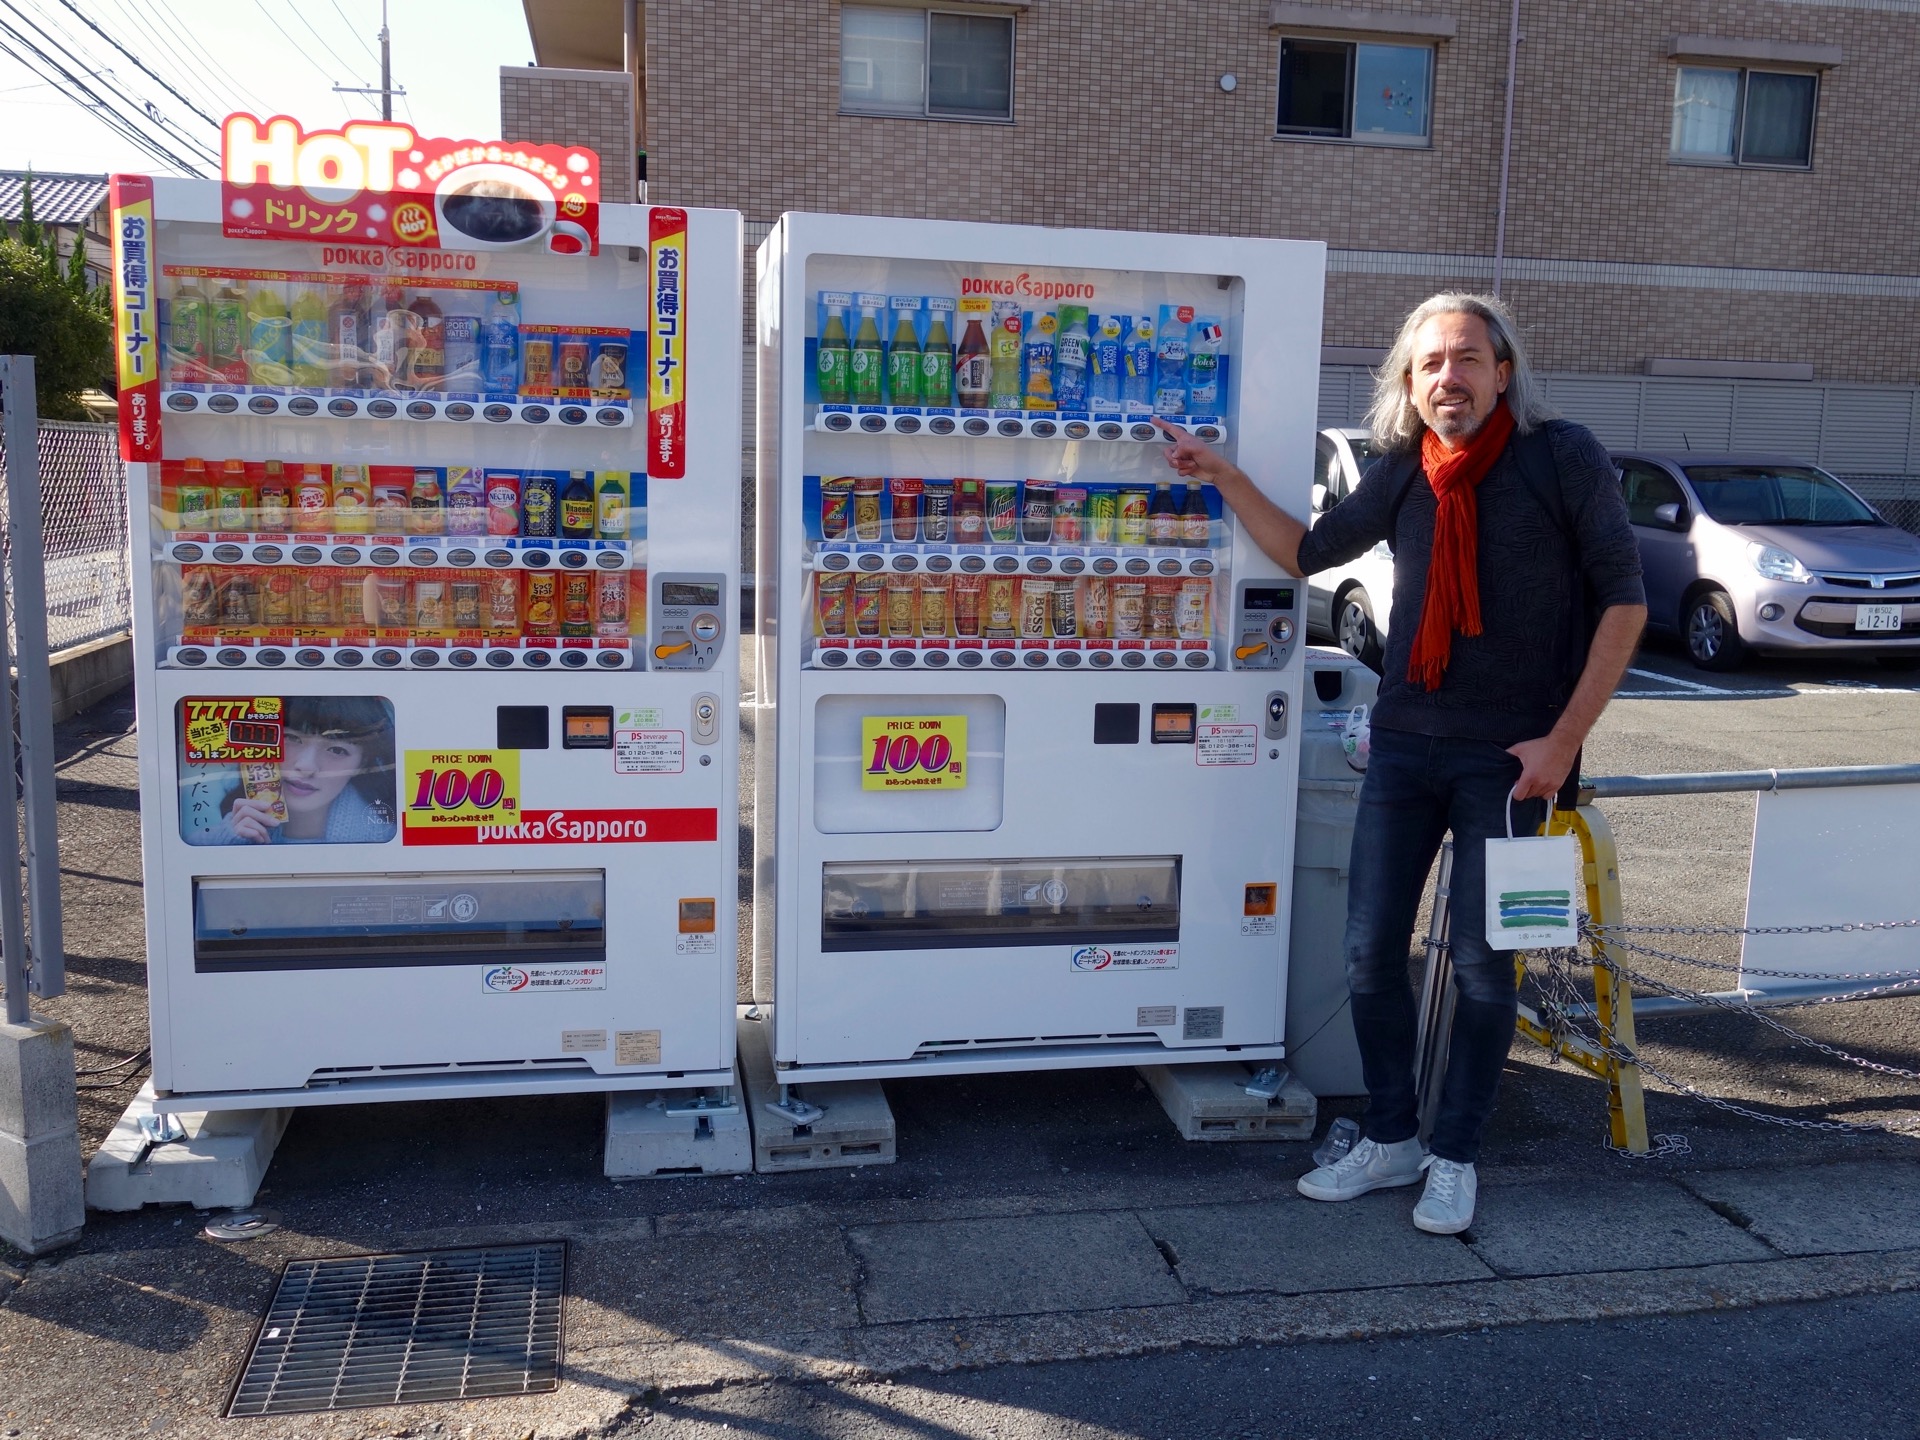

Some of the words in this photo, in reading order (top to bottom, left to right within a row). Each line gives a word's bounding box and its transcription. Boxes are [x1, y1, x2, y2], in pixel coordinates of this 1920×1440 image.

[227, 116, 414, 206] HOT
[266, 199, 358, 235] ドリンク
[401, 220, 425, 233] HOT
[323, 247, 383, 265] pokka
[386, 246, 476, 272] sapporo
[175, 267, 230, 277] お買得コーナー
[454, 280, 507, 290] お買得コーナー
[962, 278, 1014, 296] pokka
[1016, 273, 1095, 300] sapporo
[121, 216, 148, 374] お買得コーナー
[446, 321, 472, 330] SPORTS
[656, 247, 680, 395] お買得コーナー
[447, 329, 471, 338] WATER
[571, 327, 620, 336] お買得コーナー
[1061, 337, 1080, 348] GREEN
[1029, 346, 1053, 358] キリン
[820, 352, 832, 371] 茶
[854, 352, 866, 371] 茶
[924, 356, 937, 375] 茶
[1029, 357, 1053, 368] レモン
[836, 354, 844, 387] 伊右衛門
[870, 355, 878, 387] 伊右衛門
[901, 357, 910, 389] 伊右衛門
[940, 358, 948, 390] 伊右衛門
[131, 392, 151, 451] あります。
[659, 413, 676, 468] あります。
[489, 493, 516, 502] NECTAR
[527, 492, 545, 500] レモン
[937, 498, 948, 539] BLACK
[533, 582, 553, 590] じっくり
[491, 594, 515, 603] ミルク
[493, 603, 515, 613] カフェ
[1032, 596, 1046, 634] BOSS
[1065, 594, 1075, 634] BLACK
[1867, 615, 1899, 628] 12-18
[193, 628, 250, 637] お買得コーナー
[269, 628, 326, 637] お買得コーナー
[385, 629, 440, 638] お買得コーナー
[458, 629, 512, 638] お買得コーナー
[256, 699, 279, 709] LUCKY
[187, 701, 250, 720] 7777
[189, 722, 225, 740] 当たる!
[887, 721, 915, 730] PRICE
[919, 721, 942, 730] DOWN
[1221, 727, 1244, 735] beverage
[233, 723, 278, 742] 7777
[643, 733, 668, 742] beverage
[188, 744, 281, 760] もう1本プレゼント!
[431, 755, 462, 764] PRICE
[467, 755, 492, 764] DOWN
[246, 763, 275, 772] じっくり
[248, 771, 278, 782] コトコト
[885, 777, 942, 785] いらっしゃいませ!!
[367, 815, 391, 825] No.1
[431, 813, 495, 822] いらっしゃいませ!!
[477, 819, 545, 843] pokka
[547, 812, 647, 842] sapporo
[530, 978, 593, 987] 地球環境に配慮したノンフロン
